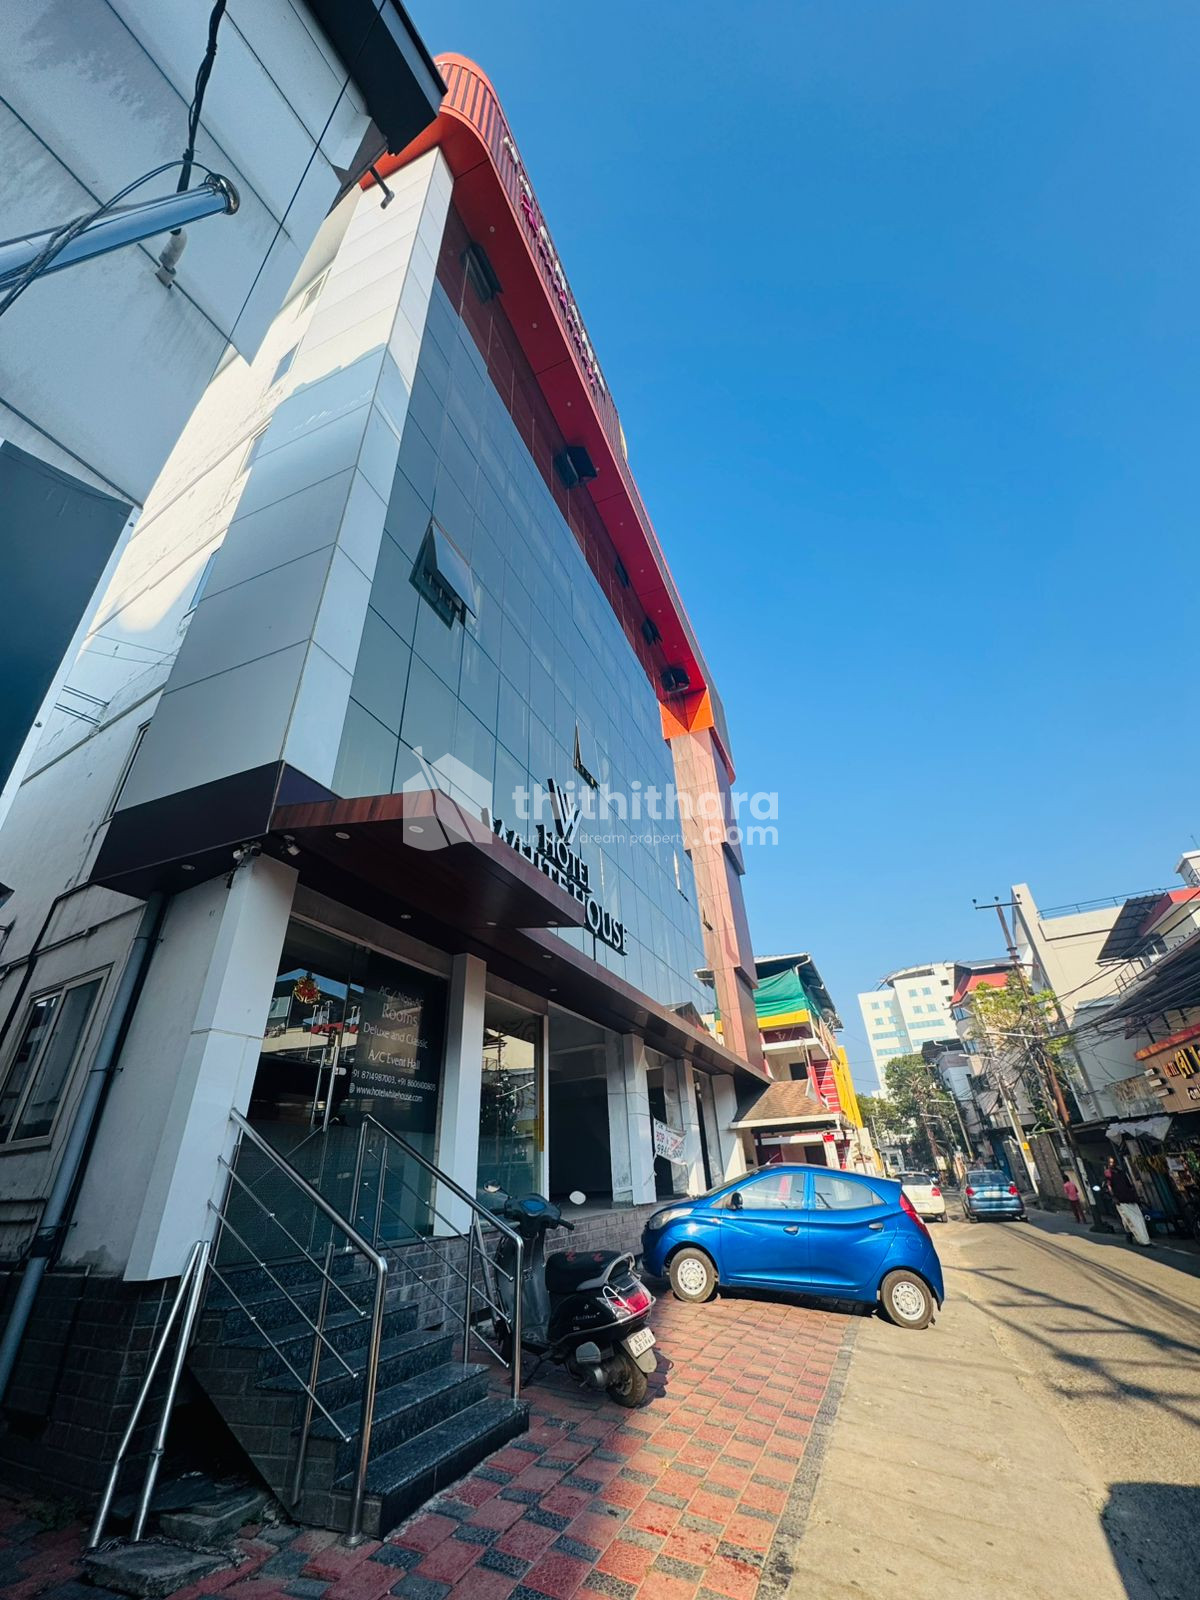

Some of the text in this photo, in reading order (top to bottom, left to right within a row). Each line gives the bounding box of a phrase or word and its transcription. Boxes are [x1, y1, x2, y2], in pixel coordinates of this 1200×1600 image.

[536, 824, 594, 894] HOTEL
[382, 1003, 418, 1027] Rooms
[363, 1022, 429, 1049] Deluxe and Classic
[368, 1049, 421, 1070] A/C Event Hall
